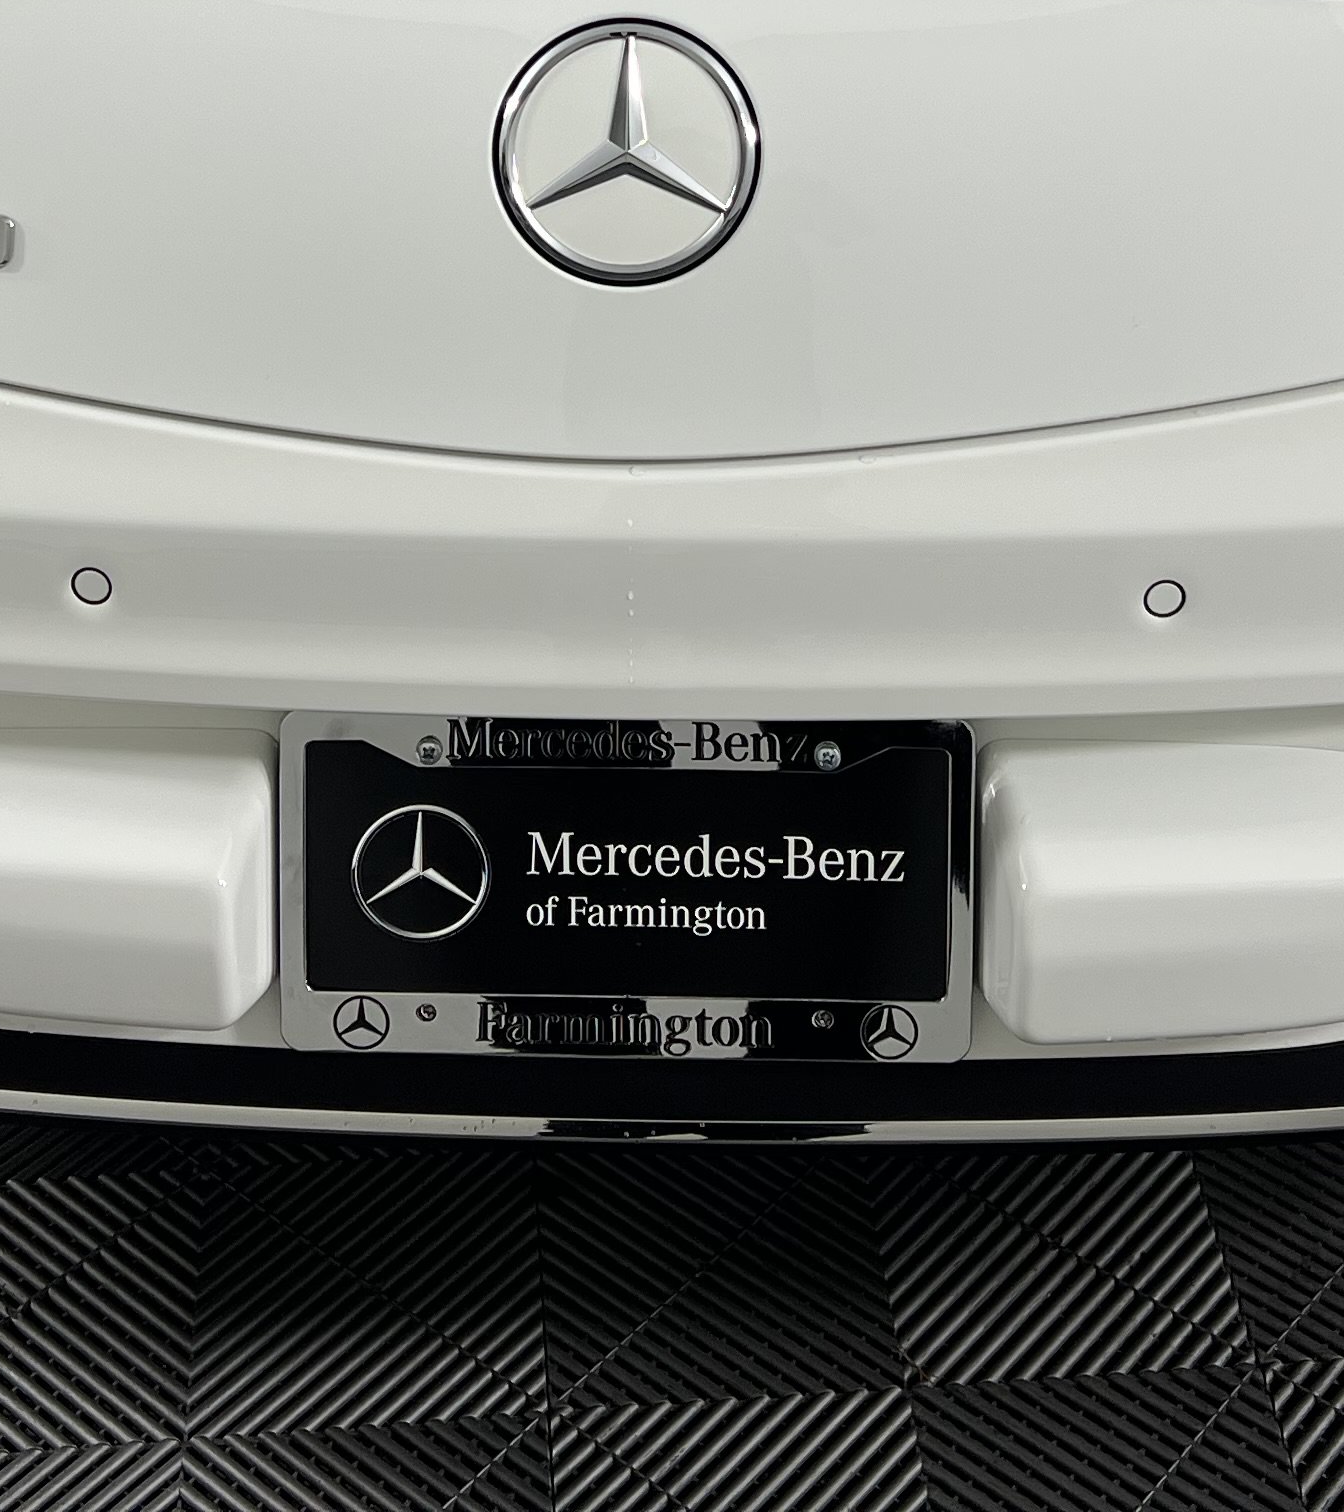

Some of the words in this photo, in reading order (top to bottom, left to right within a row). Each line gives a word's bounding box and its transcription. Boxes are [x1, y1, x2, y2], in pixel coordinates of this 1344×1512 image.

[446, 717, 809, 763] Mercedes-Benz
[526, 832, 906, 883] Mercedes-Benz
[526, 896, 558, 928] of
[567, 897, 767, 937] Farmington
[475, 1000, 775, 1057] Farmington
